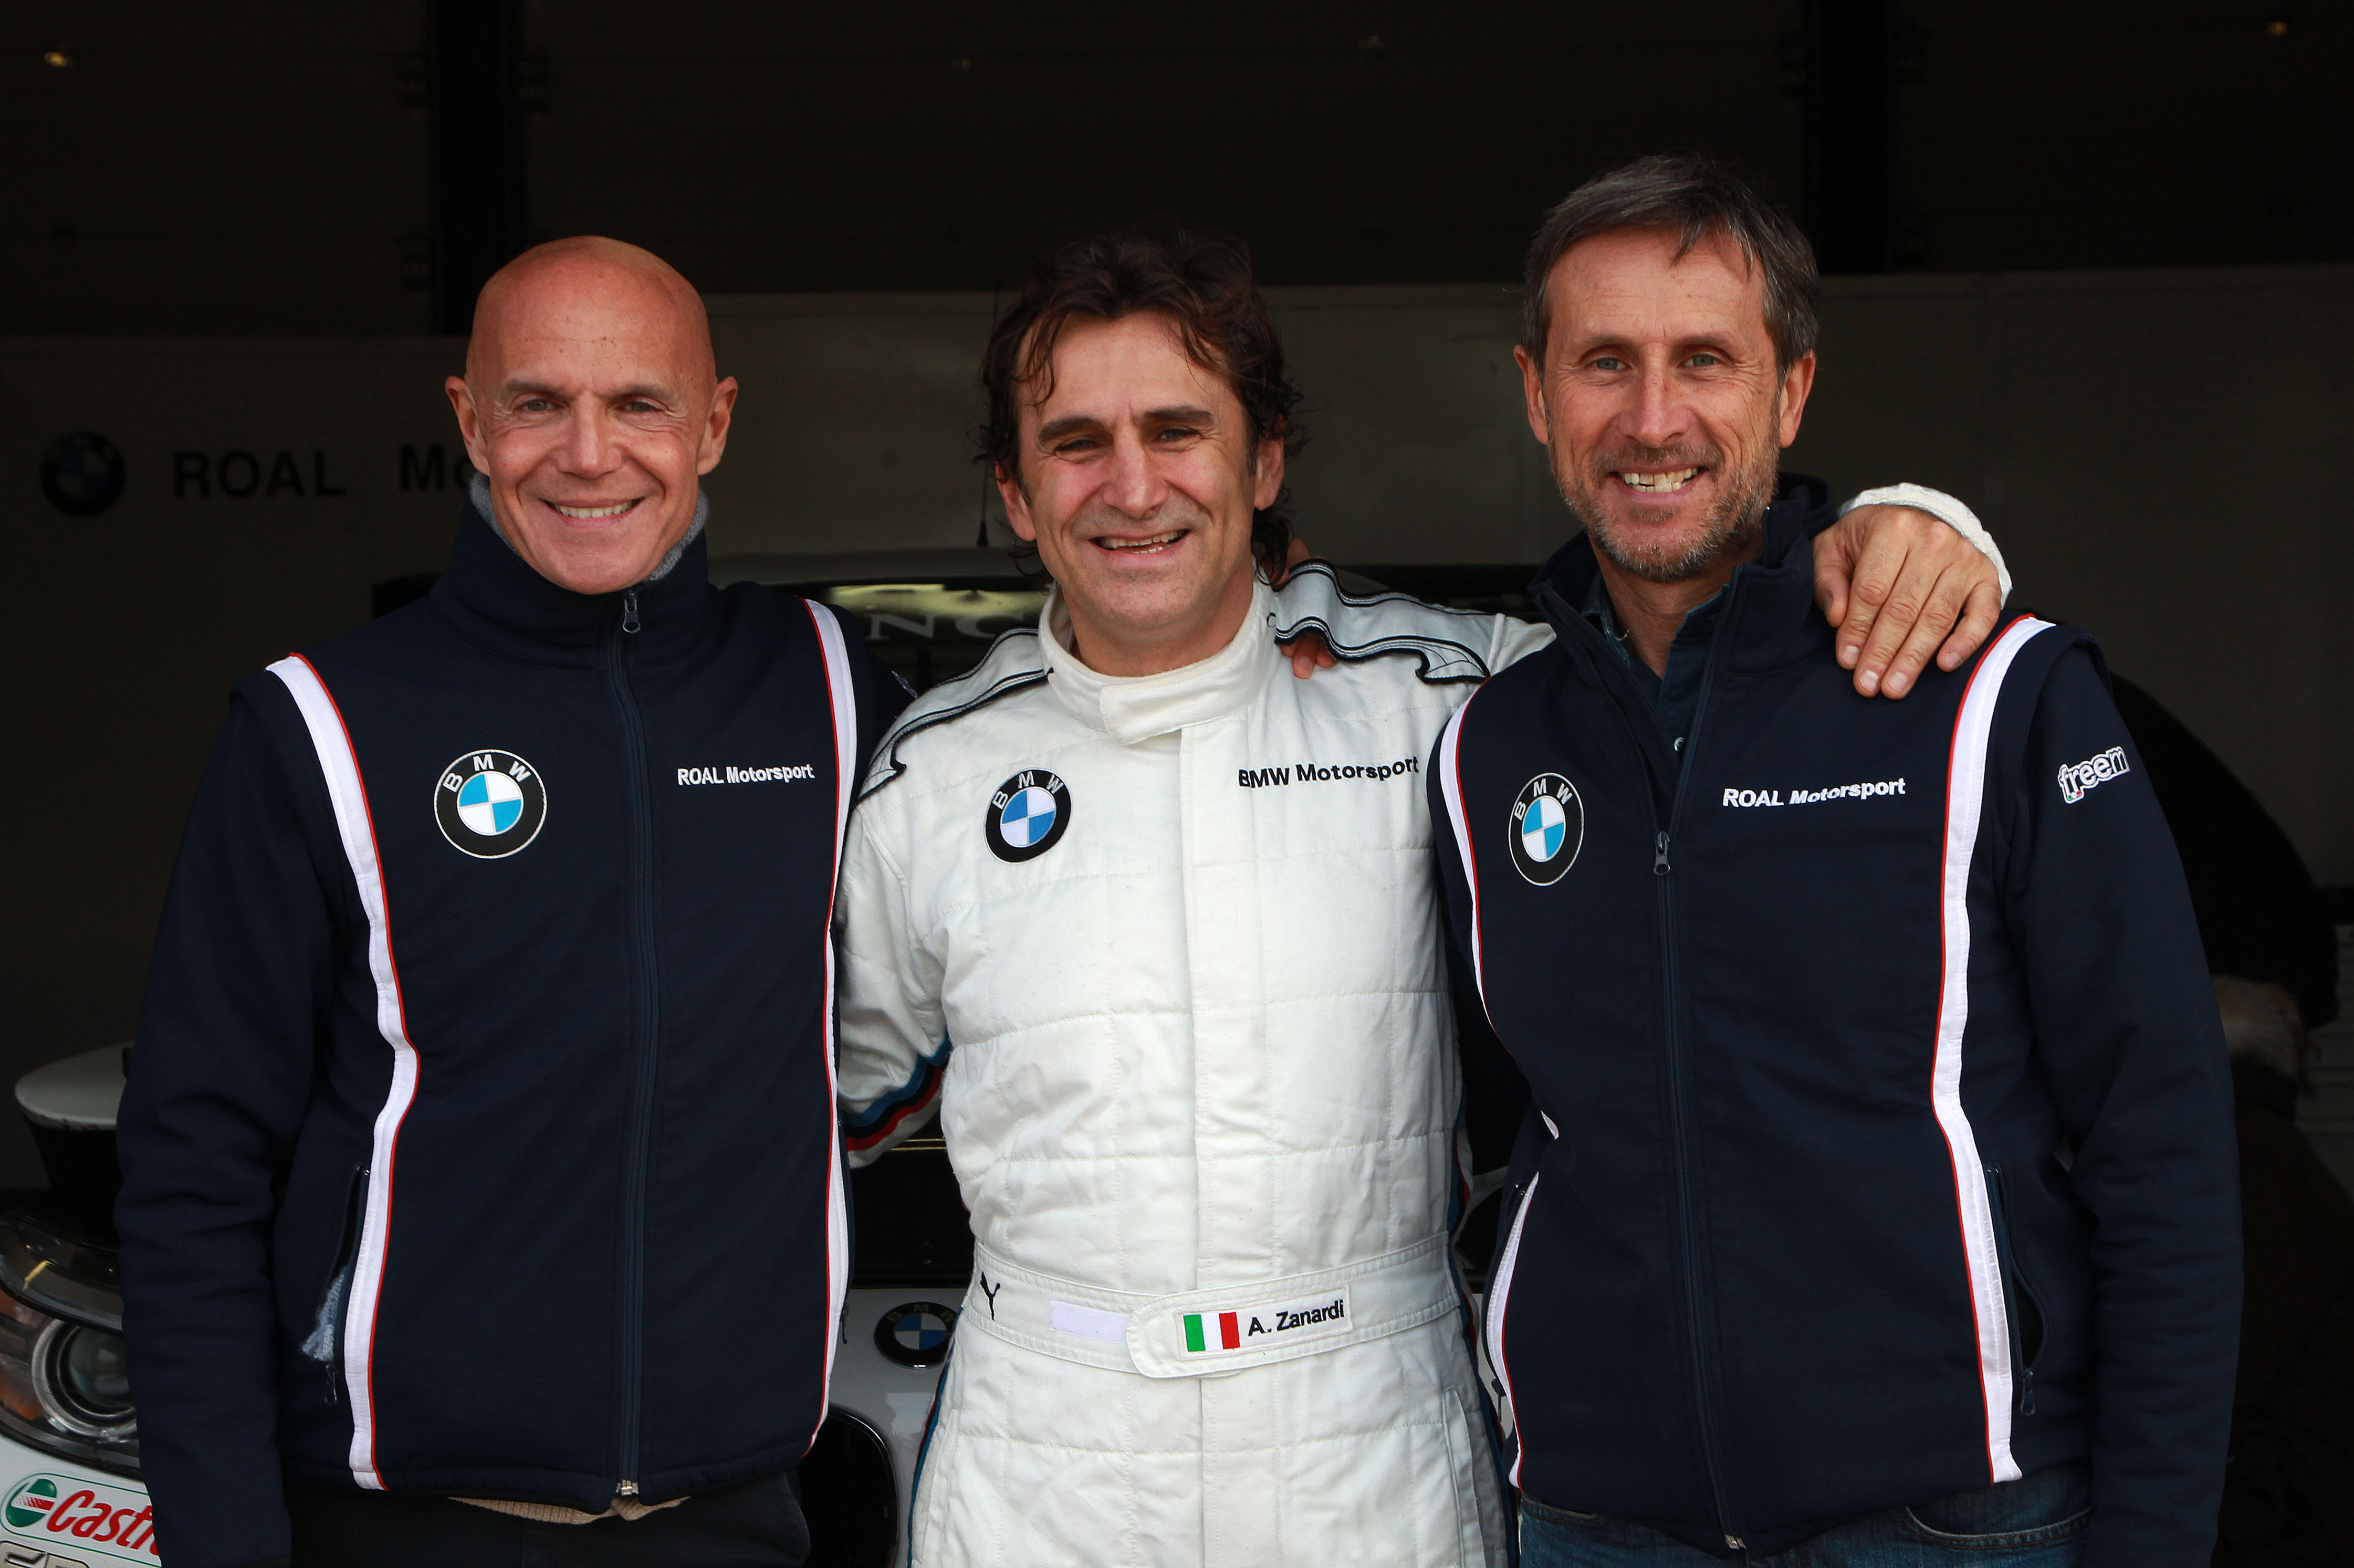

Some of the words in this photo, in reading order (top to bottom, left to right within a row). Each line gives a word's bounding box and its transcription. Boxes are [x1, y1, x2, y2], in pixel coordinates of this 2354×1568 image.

[174, 449, 346, 498] ROAL
[443, 754, 531, 793] BMW
[677, 766, 725, 786] ROAL
[726, 764, 815, 784] Motorsport
[991, 770, 1064, 810] BMW
[1238, 767, 1290, 788] BMW
[1295, 756, 1420, 782] Motorsport
[2058, 746, 2130, 803] freem
[1514, 778, 1573, 820] BMW
[1722, 788, 1784, 808] ROAL
[1789, 777, 1906, 805] Motorsport
[886, 1303, 957, 1323] BMW
[1248, 1317, 1272, 1337] A.
[1276, 1299, 1345, 1332] Zanardi
[47, 1490, 159, 1556] Castr
